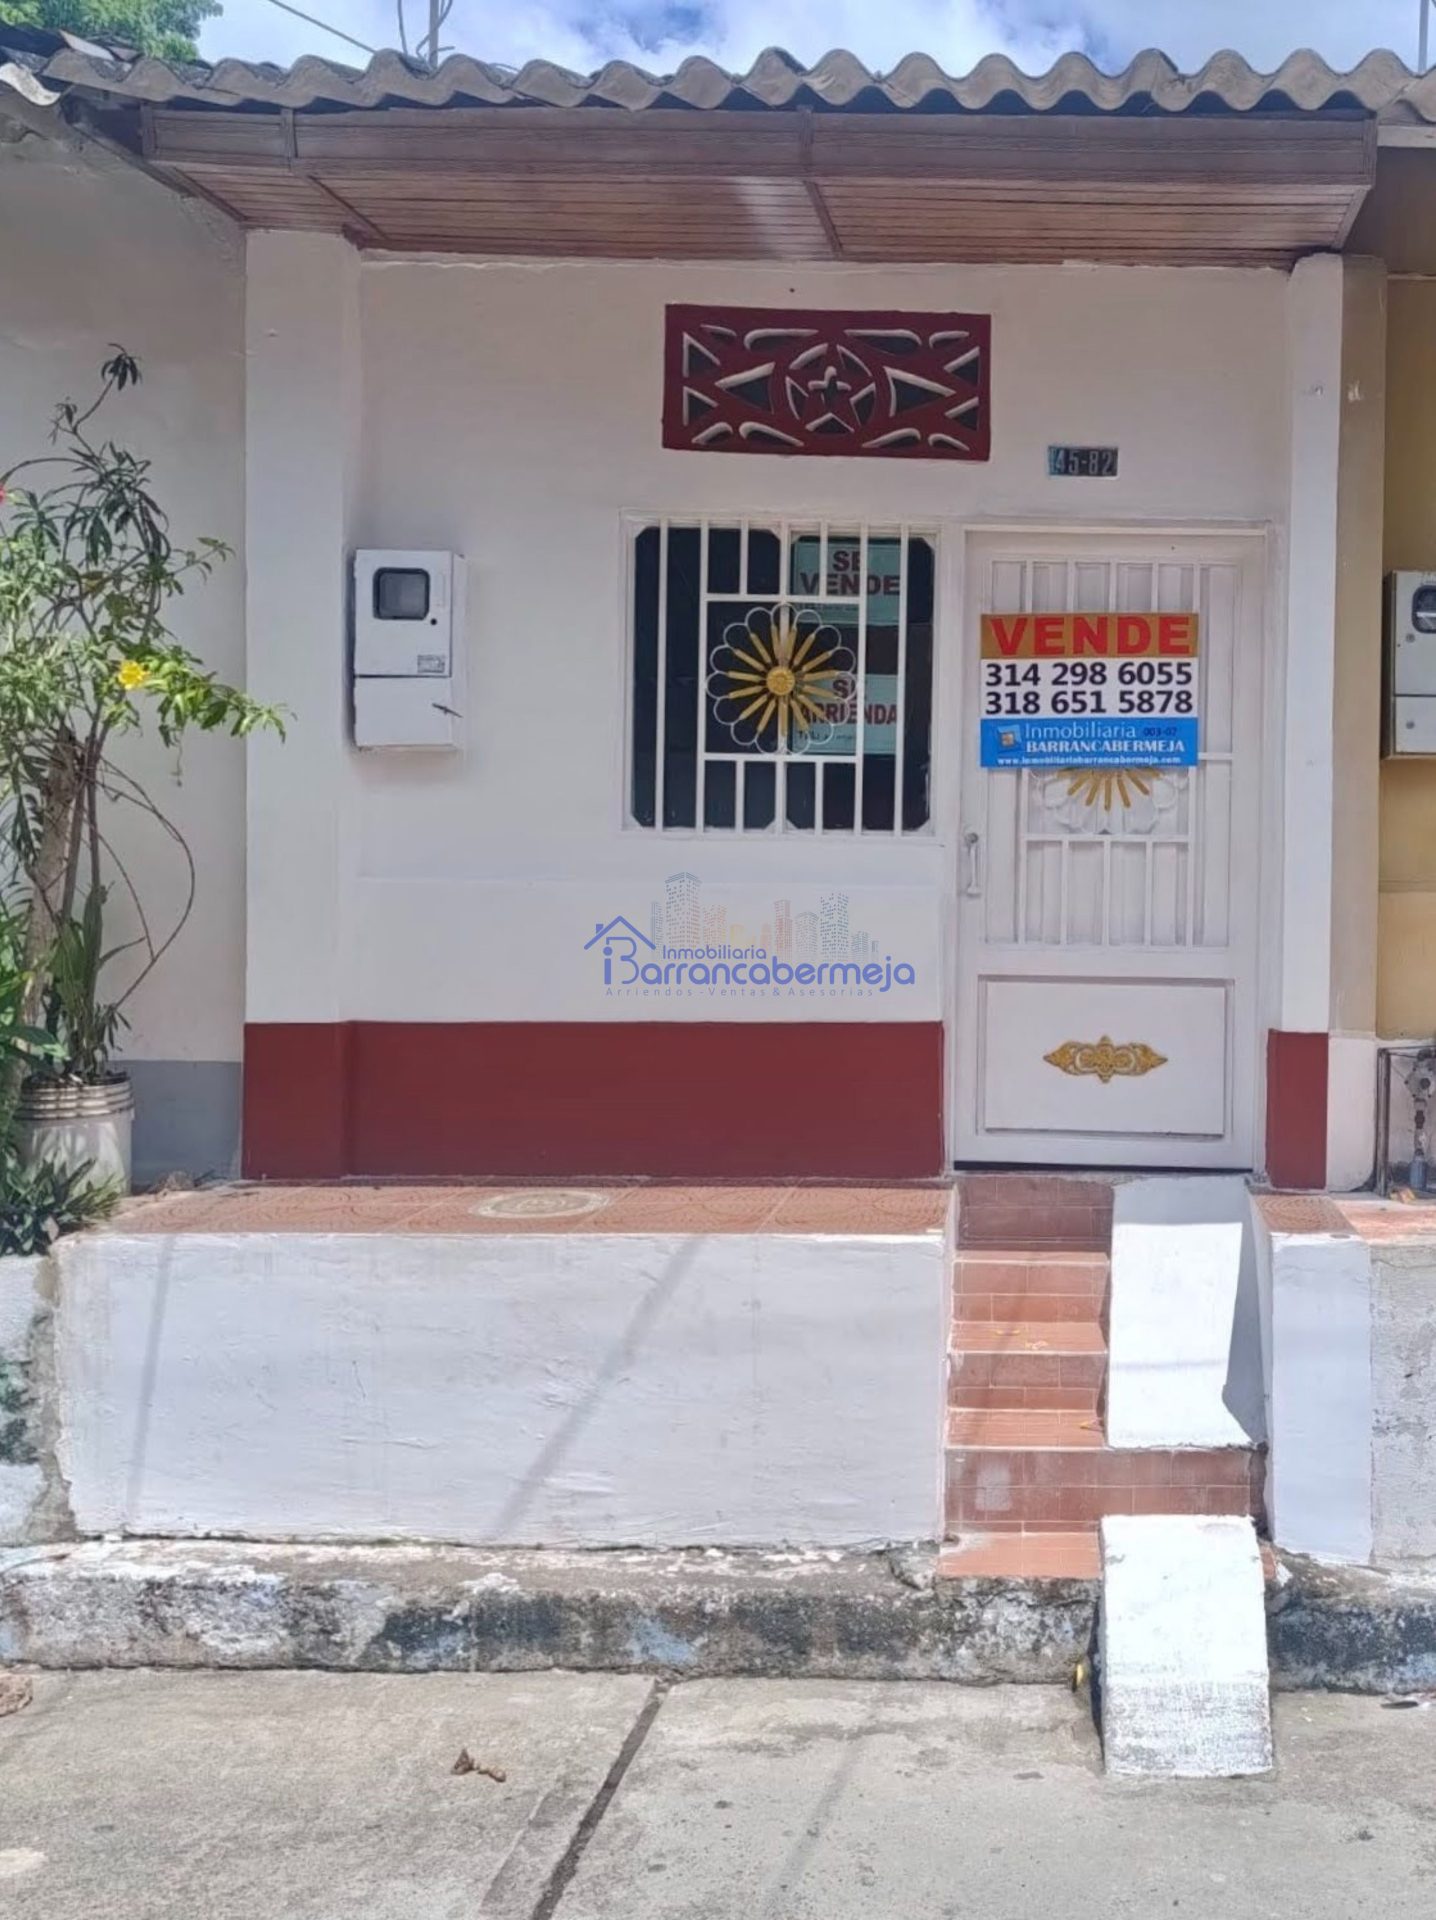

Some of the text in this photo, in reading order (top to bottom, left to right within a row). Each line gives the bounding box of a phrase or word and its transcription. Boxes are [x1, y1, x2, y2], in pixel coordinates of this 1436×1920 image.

[1055, 448, 1113, 475] 45-82
[800, 573, 901, 596] VENDE
[990, 616, 1191, 656] VENDE
[985, 662, 1192, 686] 314 298 6055
[985, 690, 1193, 715] 318 651 5878
[1025, 722, 1137, 738] Inmobiliaria
[1026, 739, 1185, 753] BARRANCABERMEJA
